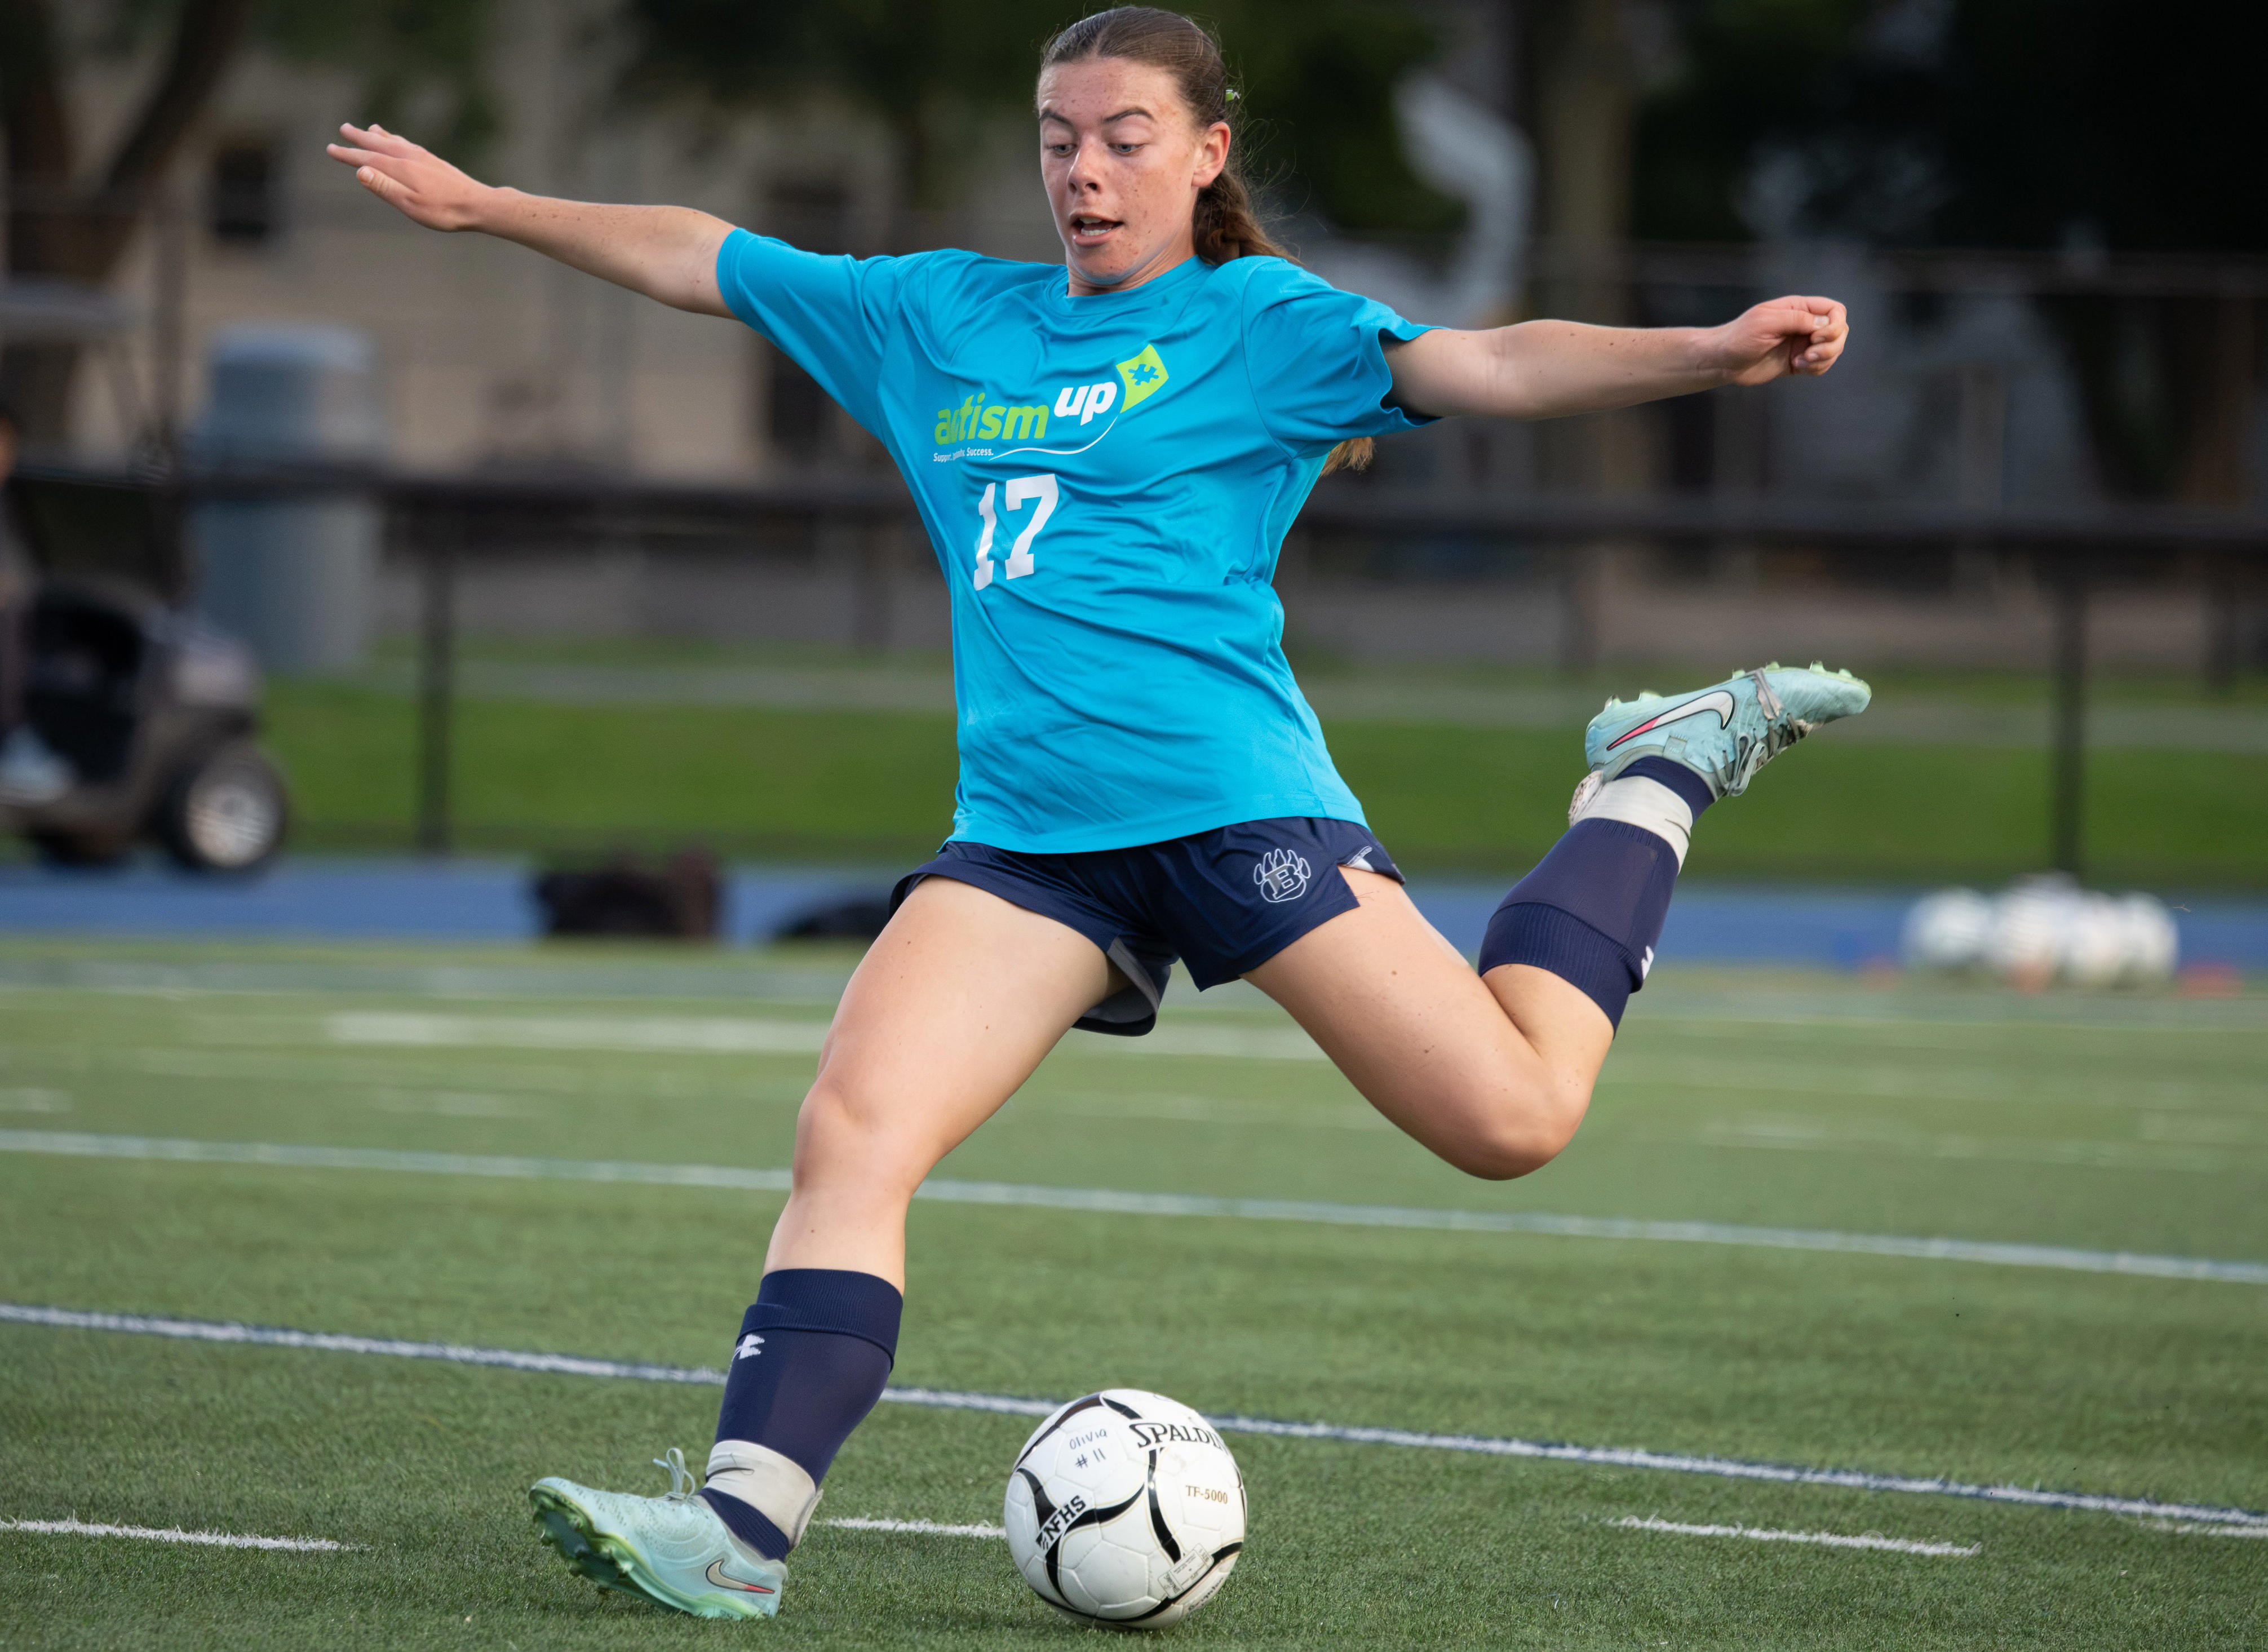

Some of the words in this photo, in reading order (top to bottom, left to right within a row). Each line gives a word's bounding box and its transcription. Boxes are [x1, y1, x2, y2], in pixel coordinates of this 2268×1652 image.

[1054, 381, 1117, 426] up
[966, 447, 994, 457] Success.
[973, 473, 1059, 591] 17
[1185, 1485, 1228, 1504] TF-5000
[1043, 1495, 1087, 1542] NFHS
